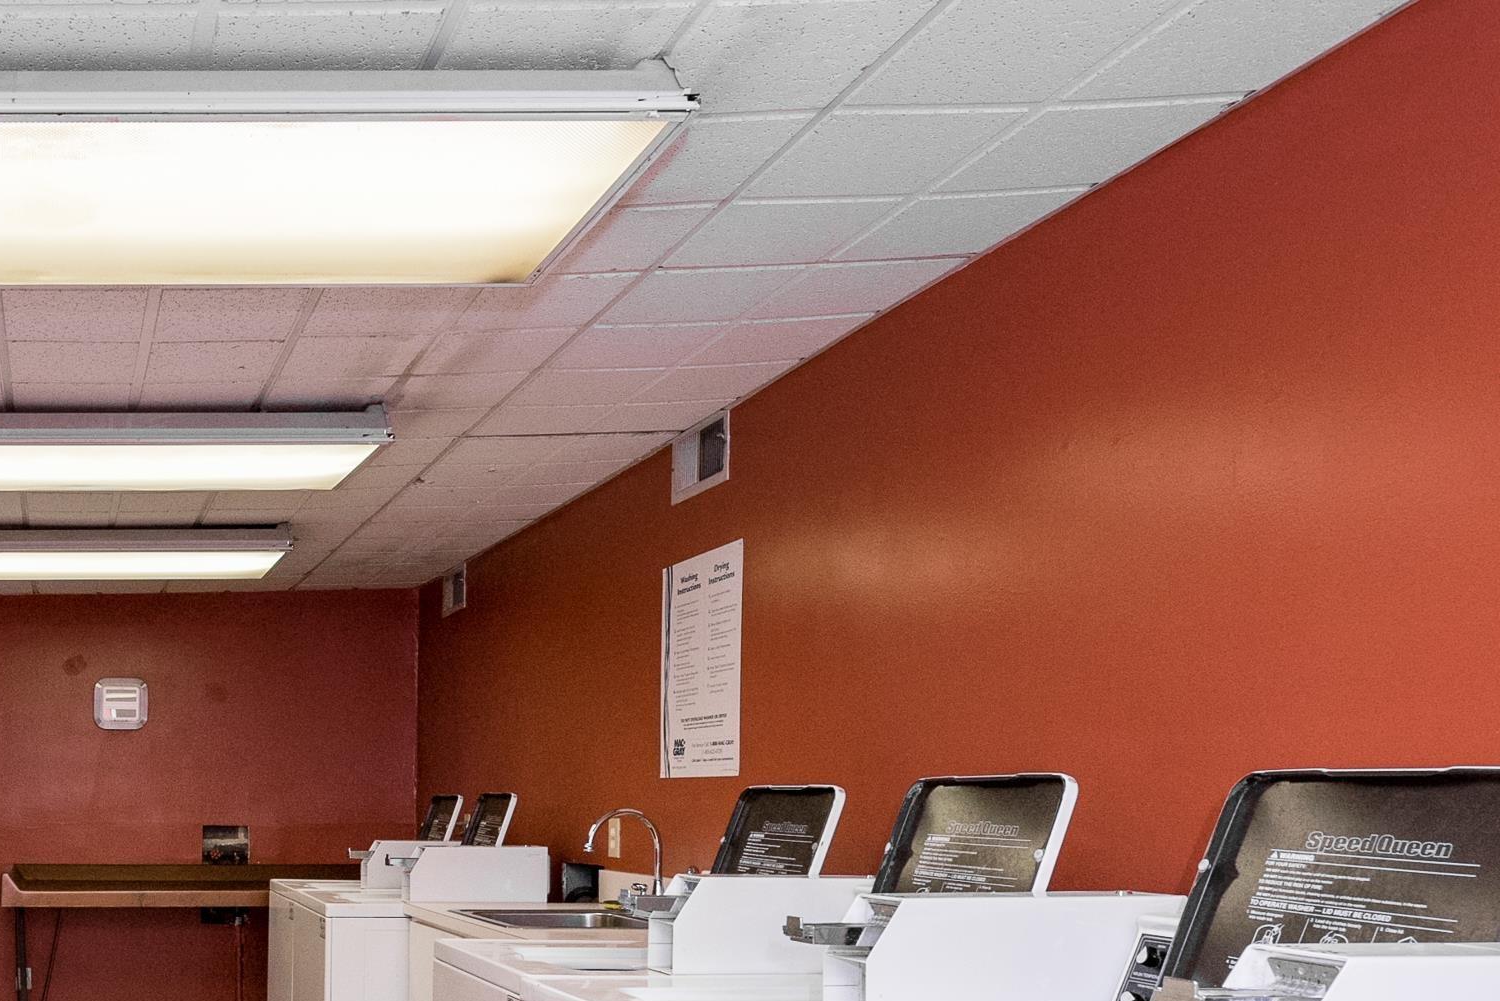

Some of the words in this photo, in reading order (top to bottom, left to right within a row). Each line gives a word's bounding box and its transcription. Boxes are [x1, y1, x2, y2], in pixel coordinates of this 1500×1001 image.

[708, 572, 735, 585] Instructions
[677, 583, 701, 596] Instructions
[945, 820, 982, 834] Speed
[982, 821, 1019, 837] Queen
[1305, 831, 1379, 853] Speed
[1376, 834, 1453, 858] Queen
[1250, 898, 1259, 906] TO
[1259, 899, 1288, 910] OPERATE
[1288, 903, 1315, 913] WASHER
[1322, 907, 1333, 915] LID
[1333, 908, 1353, 918] MUST
[1352, 911, 1363, 919] BE
[1363, 912, 1392, 922] CLOSED
